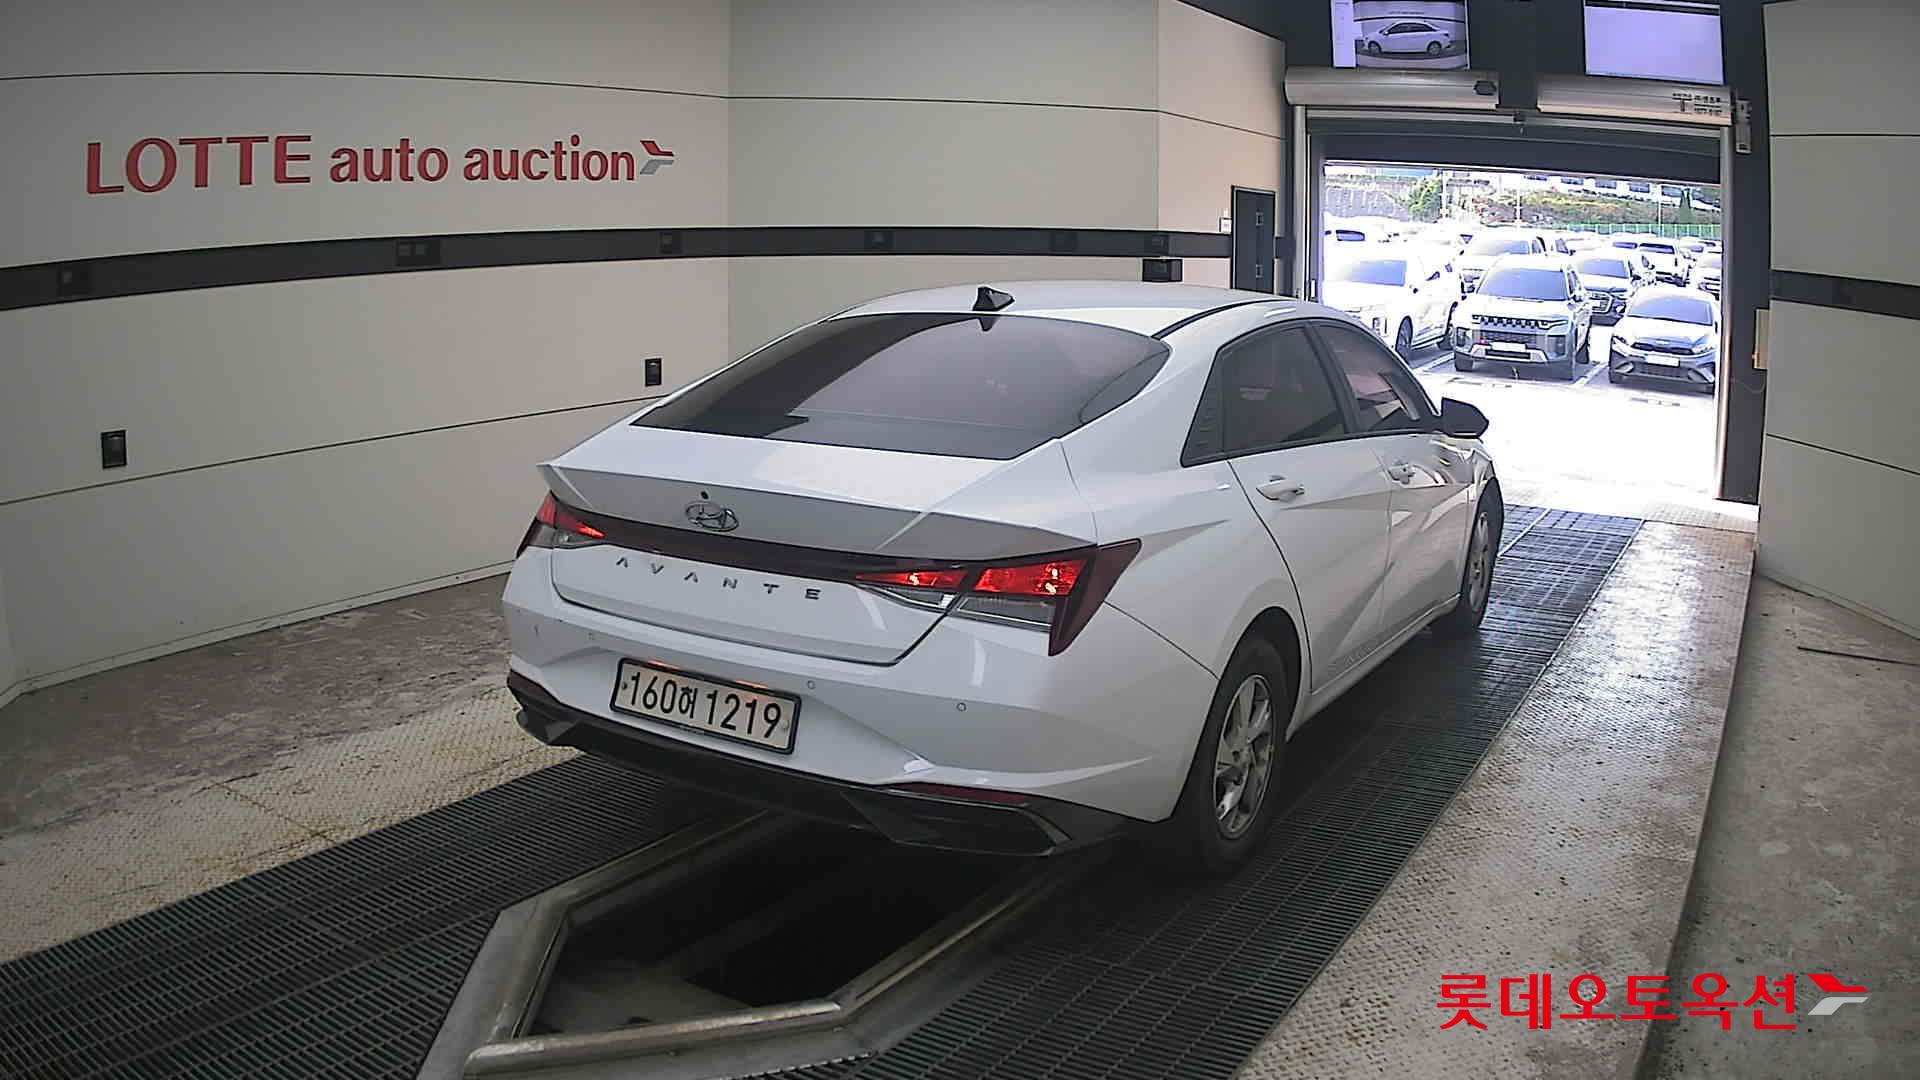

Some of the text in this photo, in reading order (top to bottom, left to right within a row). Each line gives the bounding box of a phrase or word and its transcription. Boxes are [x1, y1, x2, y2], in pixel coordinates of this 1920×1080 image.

[87, 134, 636, 194] LOTTE auto auction
[616, 557, 821, 600] AVANTE
